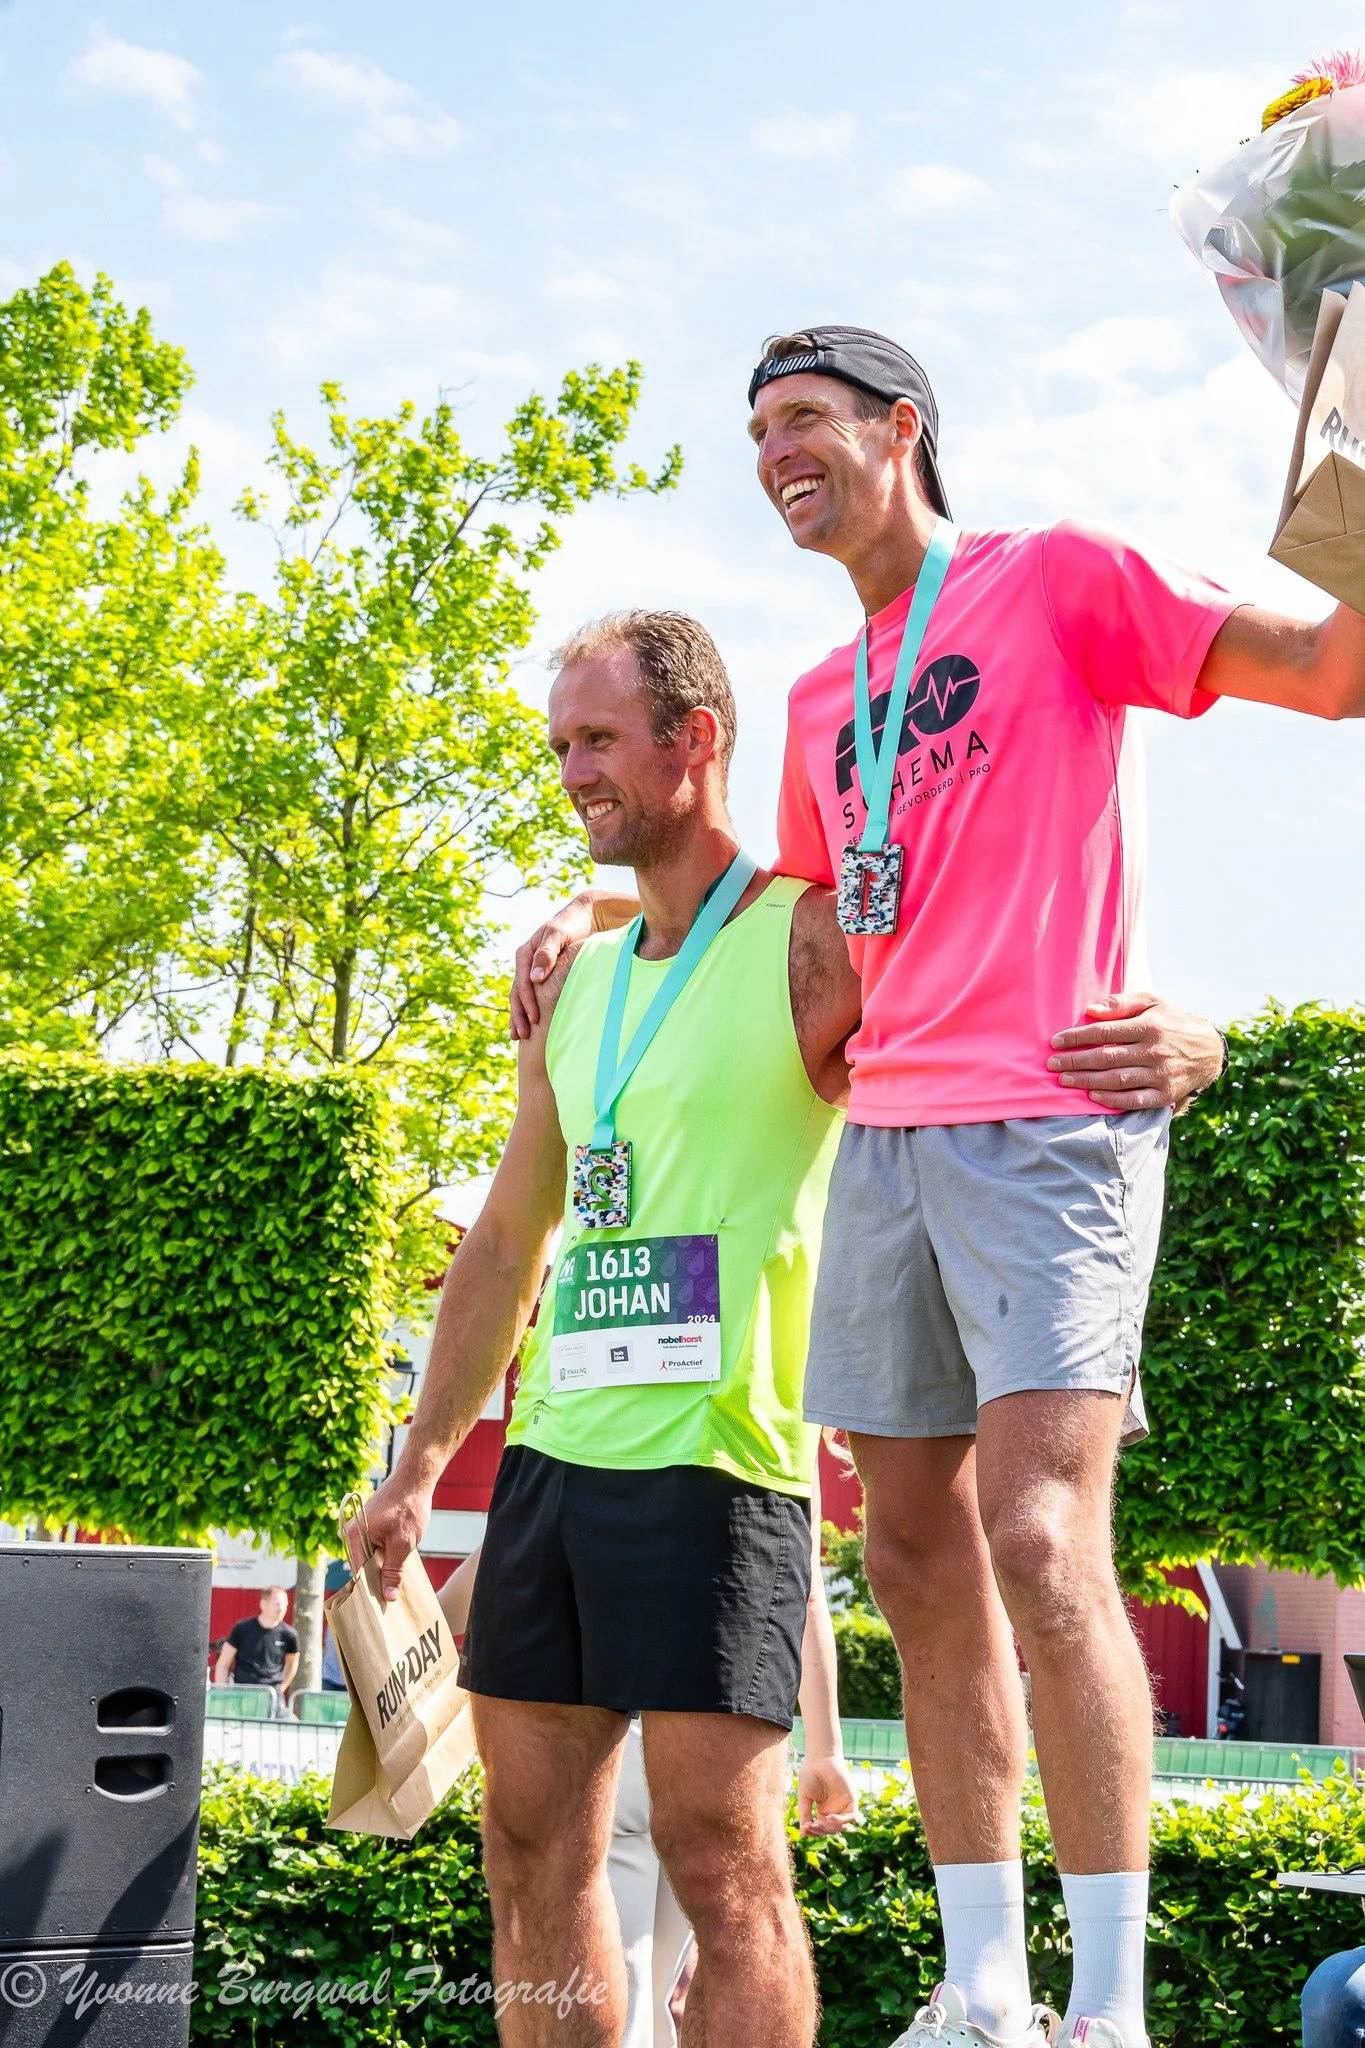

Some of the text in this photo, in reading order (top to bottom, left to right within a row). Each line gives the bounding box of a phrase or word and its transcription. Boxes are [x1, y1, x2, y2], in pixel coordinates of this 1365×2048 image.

[842, 729, 990, 830] SHEMA
[896, 763, 991, 816] GEVORDERD PRO
[585, 1245, 651, 1281] 1613
[574, 1282, 671, 1321] JOHAN
[686, 1314, 716, 1325] 2024
[658, 1335, 703, 1344] nobelhorst
[668, 1359, 703, 1367] ProActief
